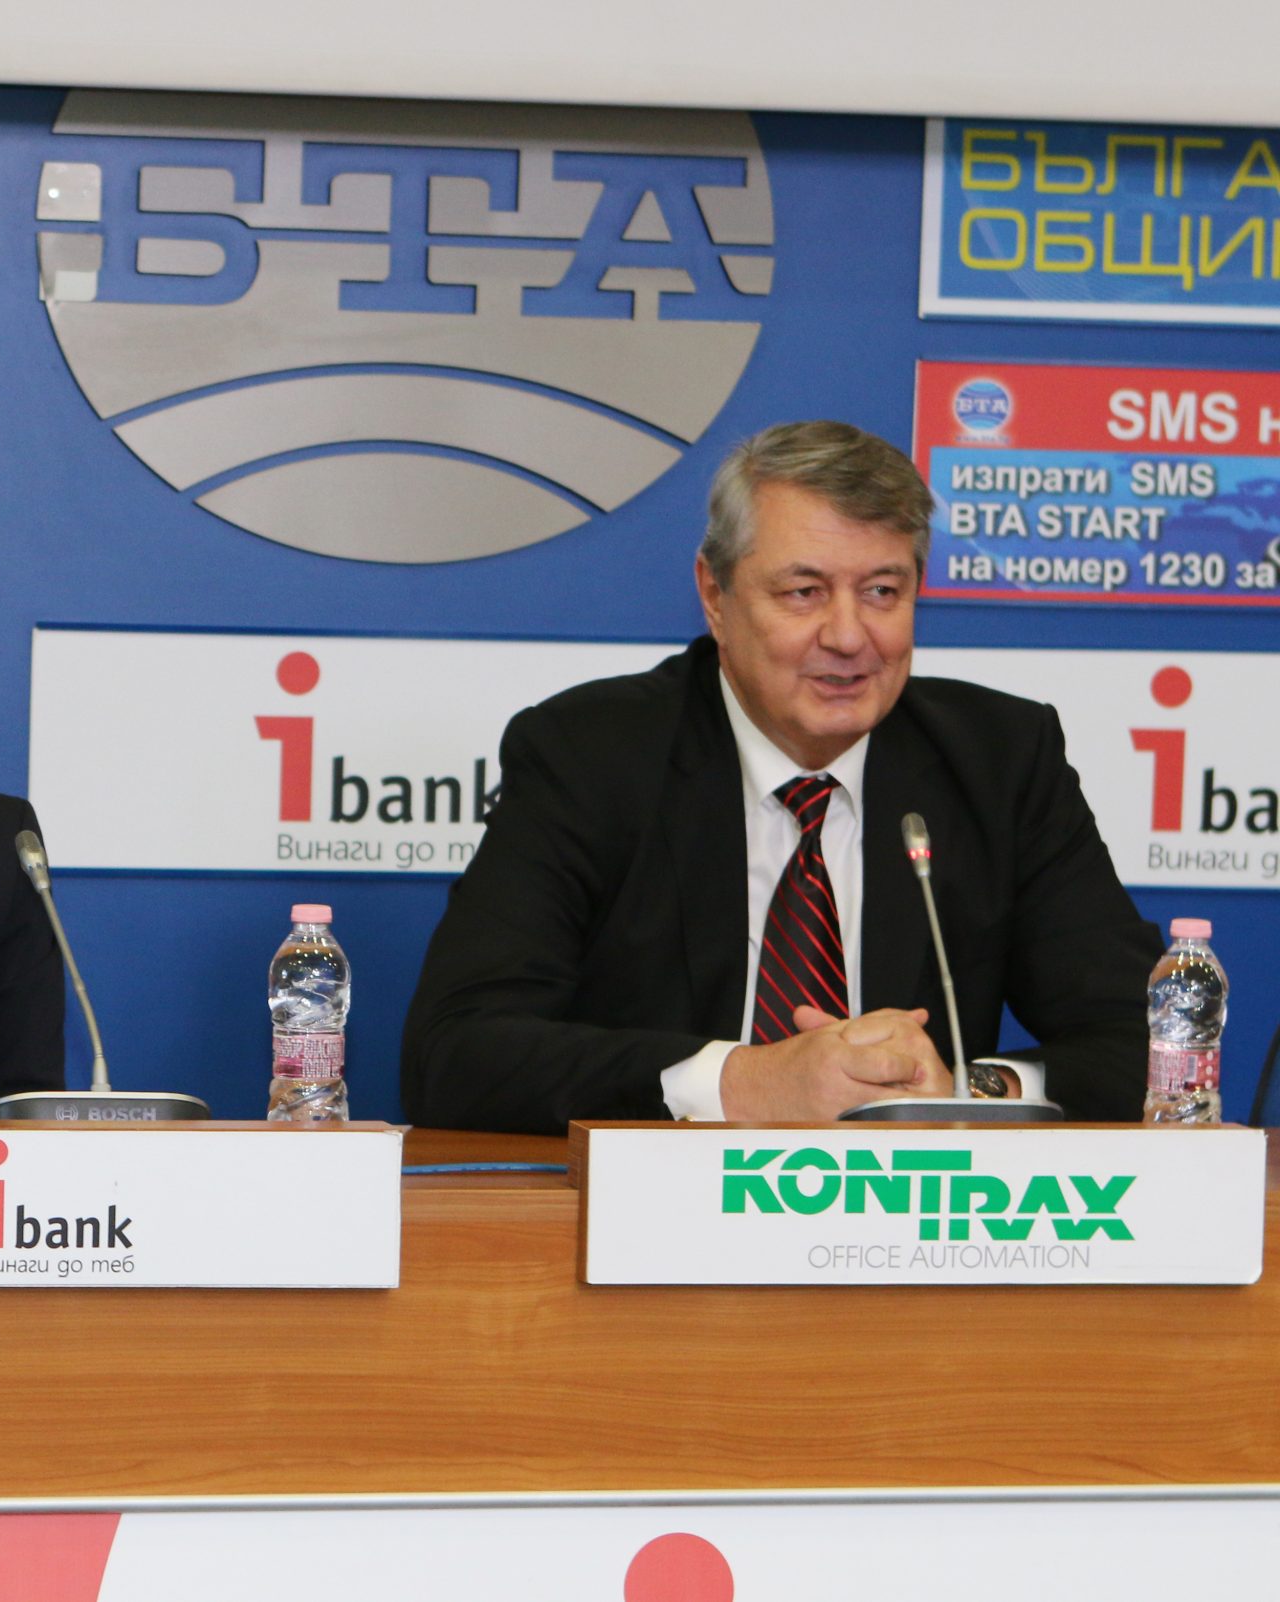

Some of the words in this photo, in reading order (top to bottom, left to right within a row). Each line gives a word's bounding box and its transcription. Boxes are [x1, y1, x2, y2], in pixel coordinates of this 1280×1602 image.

[961, 127, 1280, 199] БЪЛГА
[42, 133, 762, 322] БТА
[959, 207, 1280, 291] ОБЩИ
[1107, 389, 1239, 443] SMS
[951, 465, 1108, 499] изпрати
[1130, 462, 1216, 497] SMS
[950, 502, 1028, 537] BTA
[1037, 504, 1166, 541] START
[948, 555, 994, 582] на
[1005, 556, 1128, 591] номер
[1139, 551, 1225, 587] 1230
[1235, 561, 1277, 589] за
[276, 833, 382, 862] Винаги
[396, 839, 435, 869] до
[1148, 843, 1249, 872] Винаги
[88, 1106, 157, 1120] BOSCH
[722, 1147, 1138, 1241] KONTRAX
[57, 1258, 83, 1278] до
[91, 1254, 135, 1273] теб
[807, 1245, 901, 1269] OFFICE
[909, 1245, 1091, 1269] AUTOMATION
